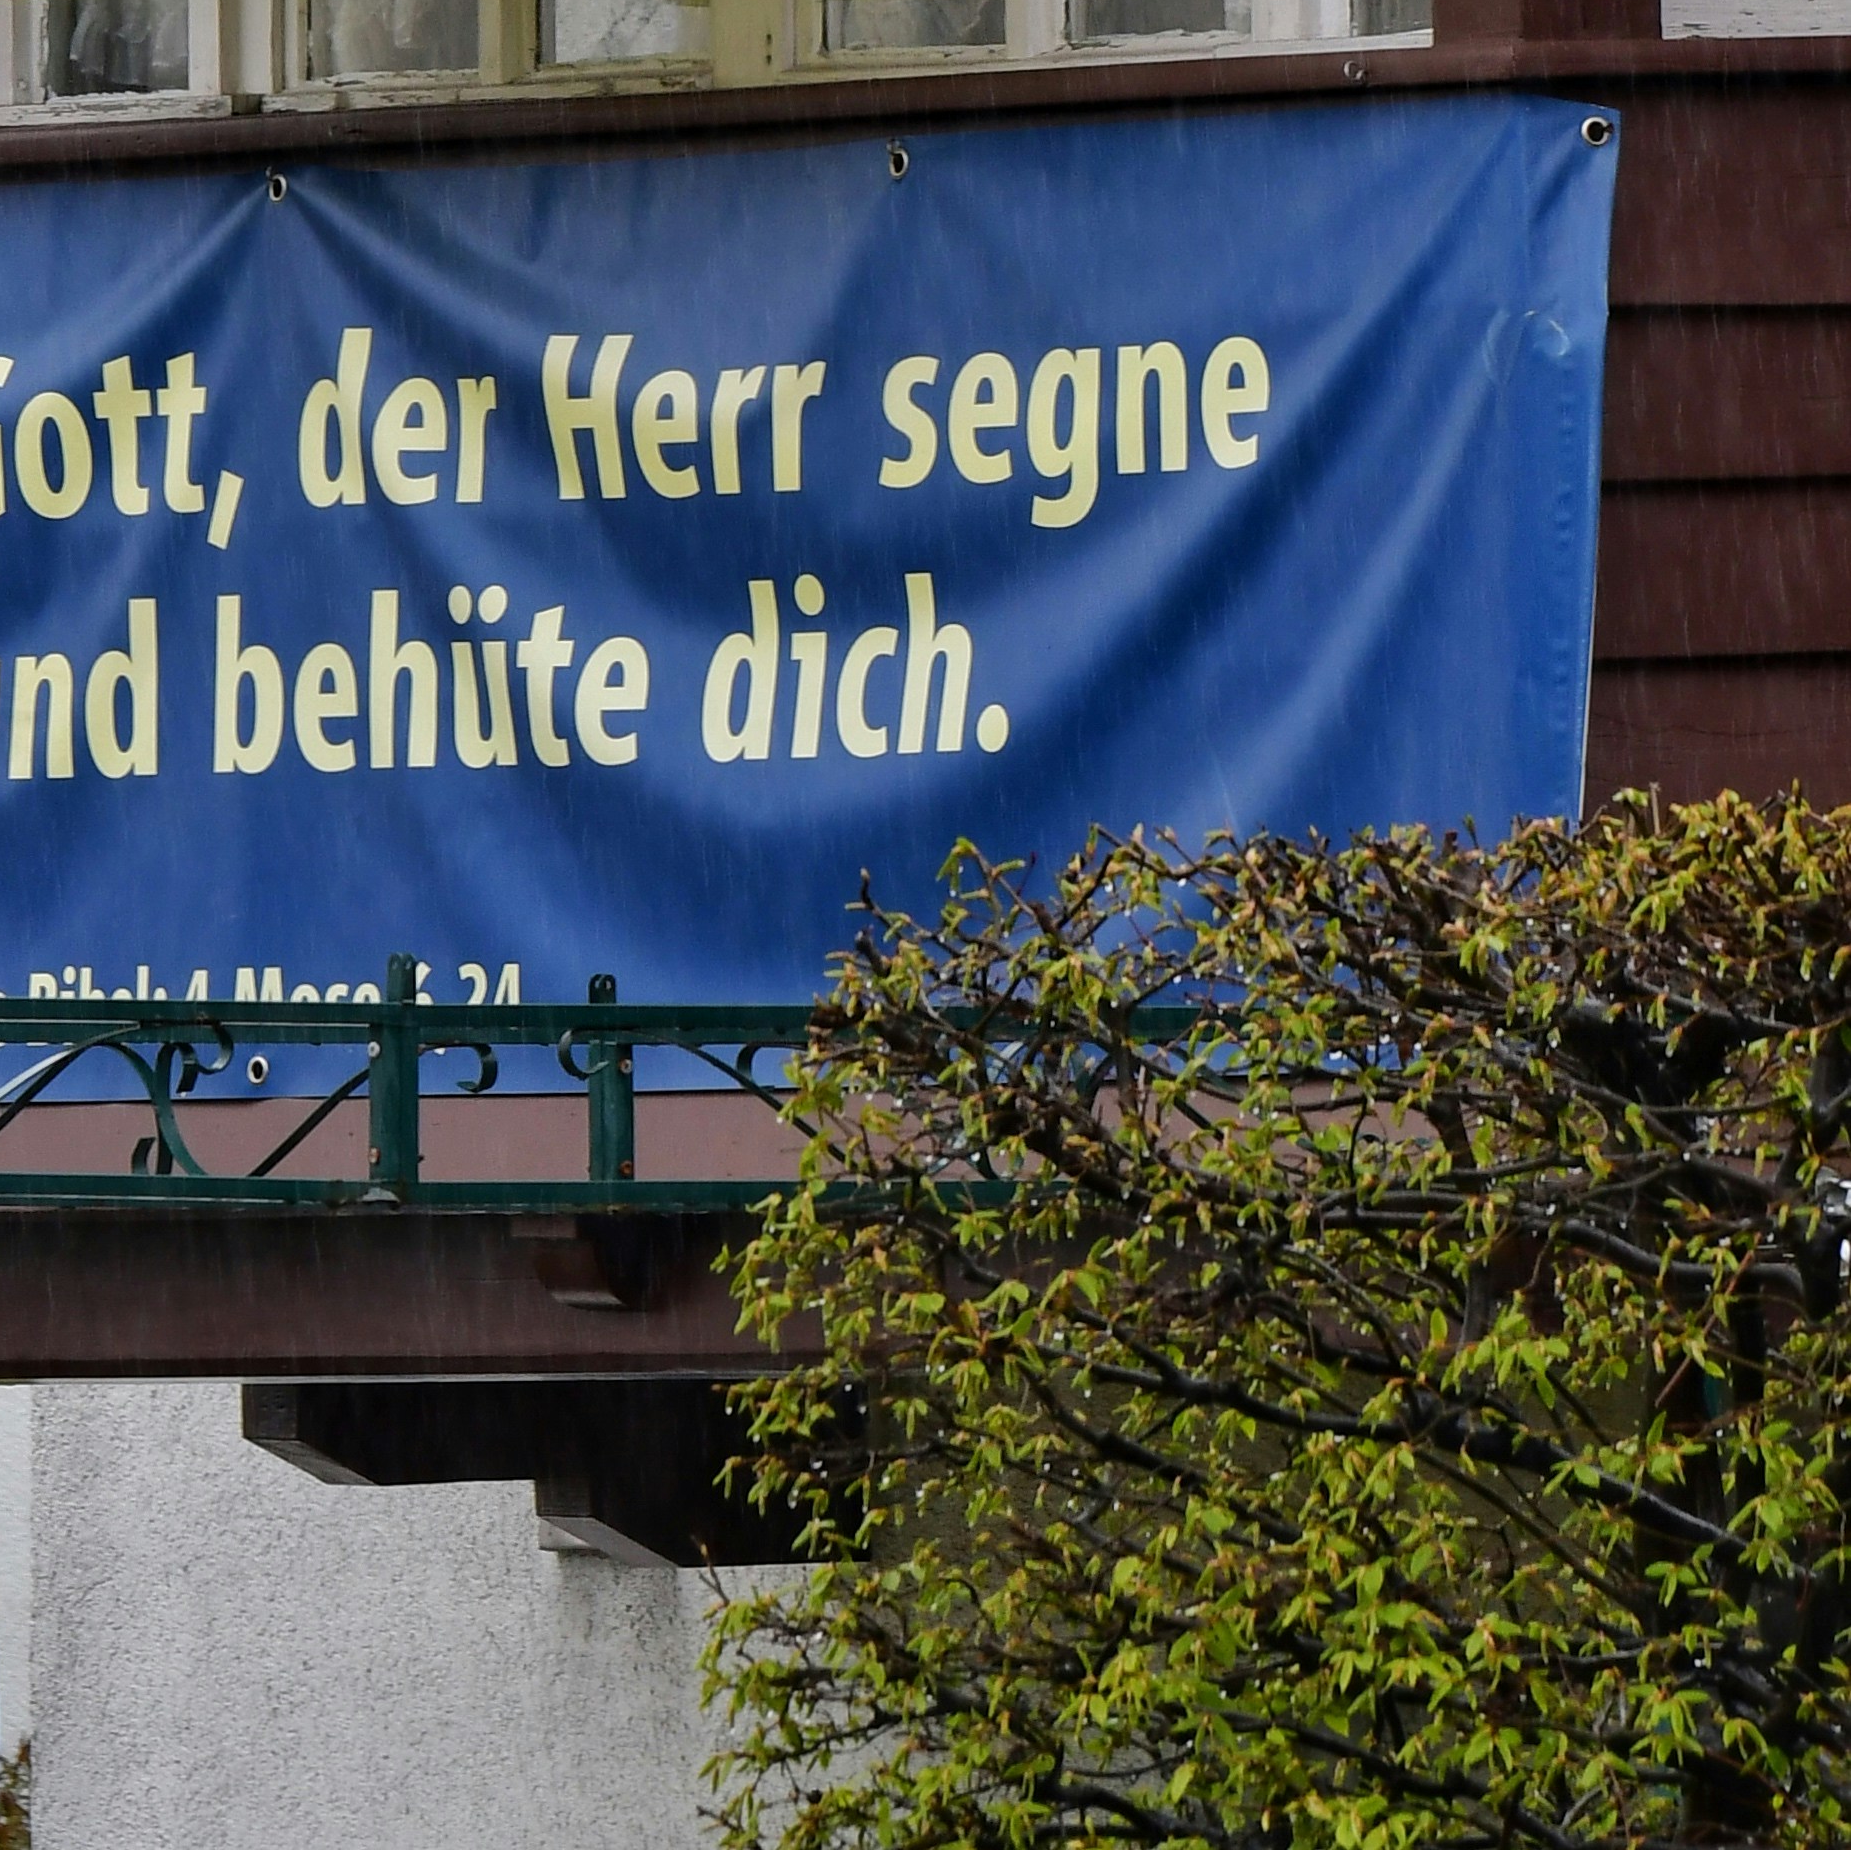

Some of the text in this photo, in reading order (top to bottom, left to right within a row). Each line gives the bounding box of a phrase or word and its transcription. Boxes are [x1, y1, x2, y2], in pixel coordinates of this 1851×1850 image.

[298, 326, 497, 509] der
[541, 333, 828, 501] Herr
[878, 335, 1271, 529] segne
[213, 584, 651, 774] behüte
[702, 571, 1010, 762] dich.
